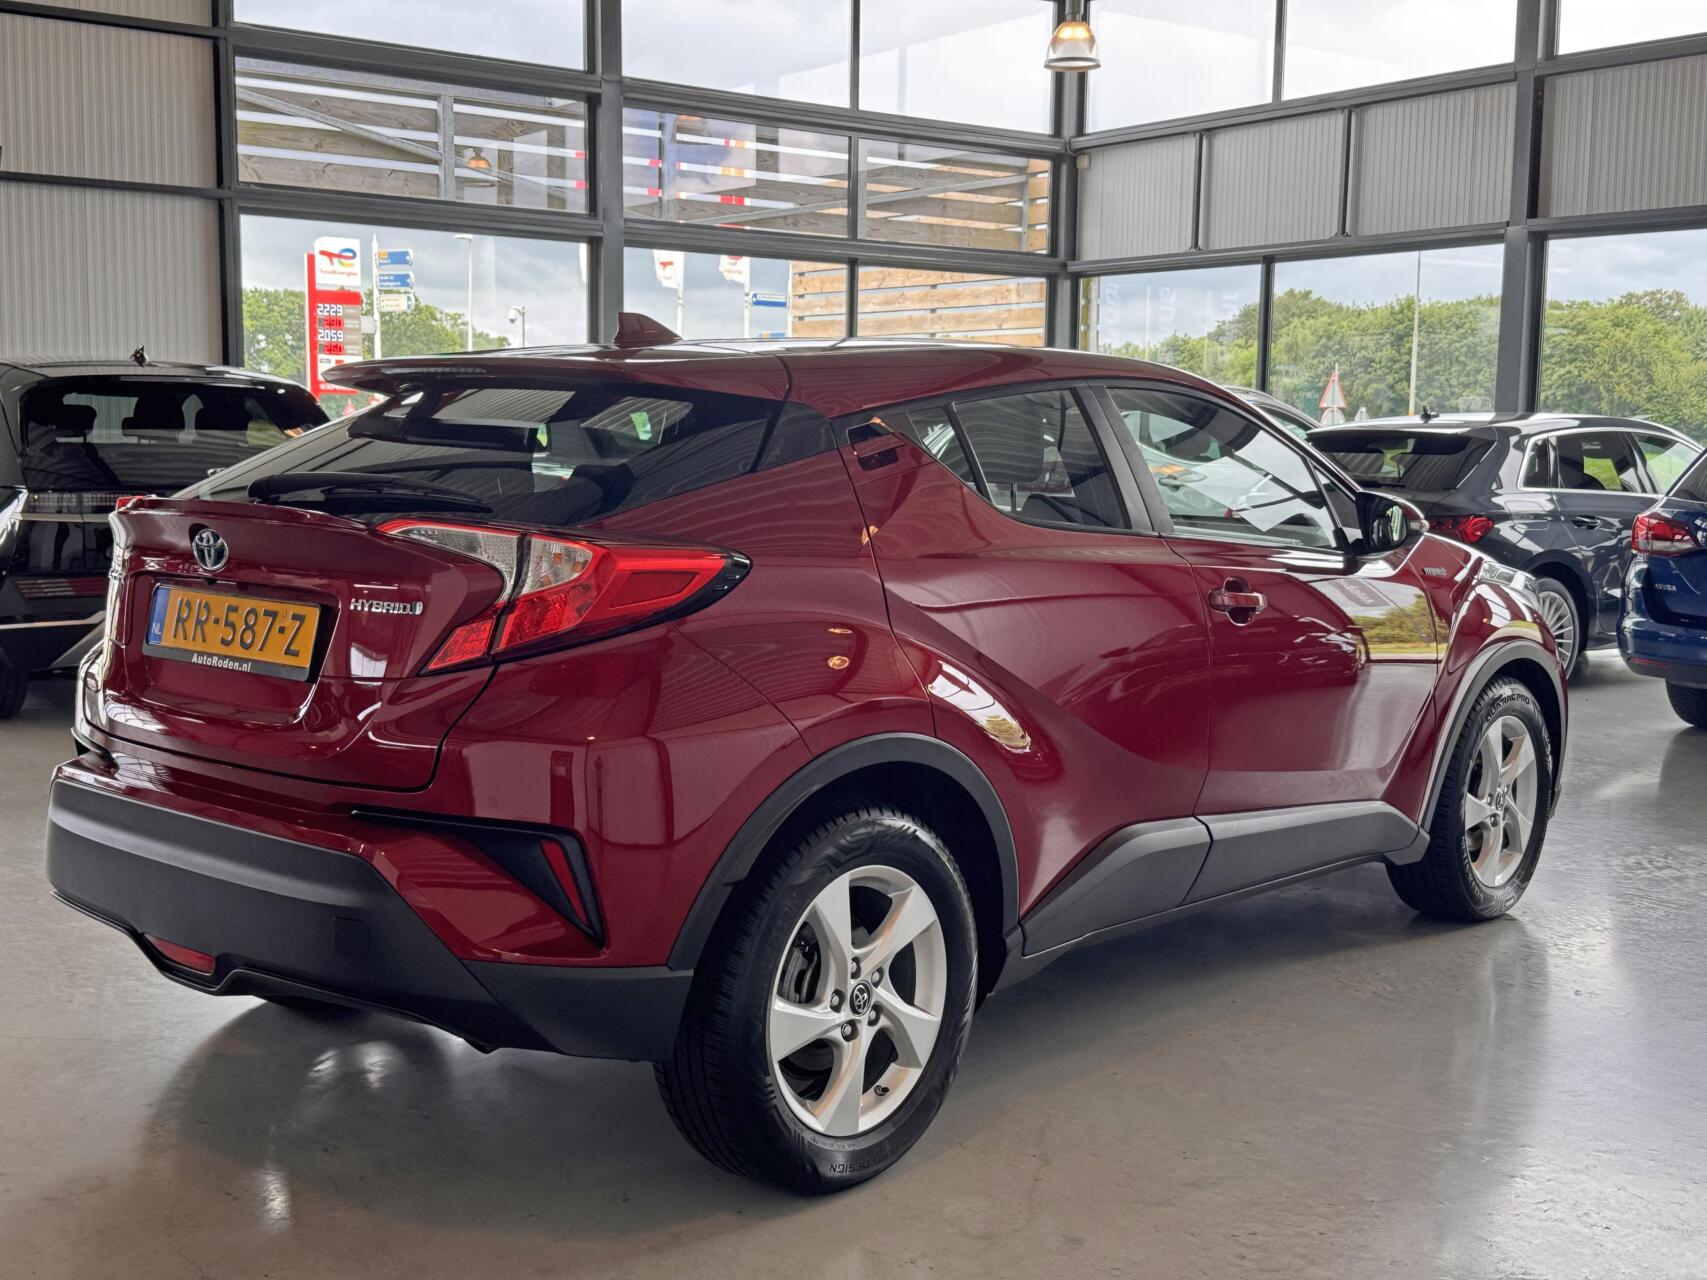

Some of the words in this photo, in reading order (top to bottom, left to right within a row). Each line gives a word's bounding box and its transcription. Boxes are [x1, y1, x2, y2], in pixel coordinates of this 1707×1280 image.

[317, 304, 343, 316] 2229
[318, 330, 344, 342] 2059
[350, 598, 411, 614] HYBRID
[151, 622, 162, 635] NL
[173, 596, 306, 657] RR-587-Z
[191, 653, 252, 672] AutoRoden.nl
